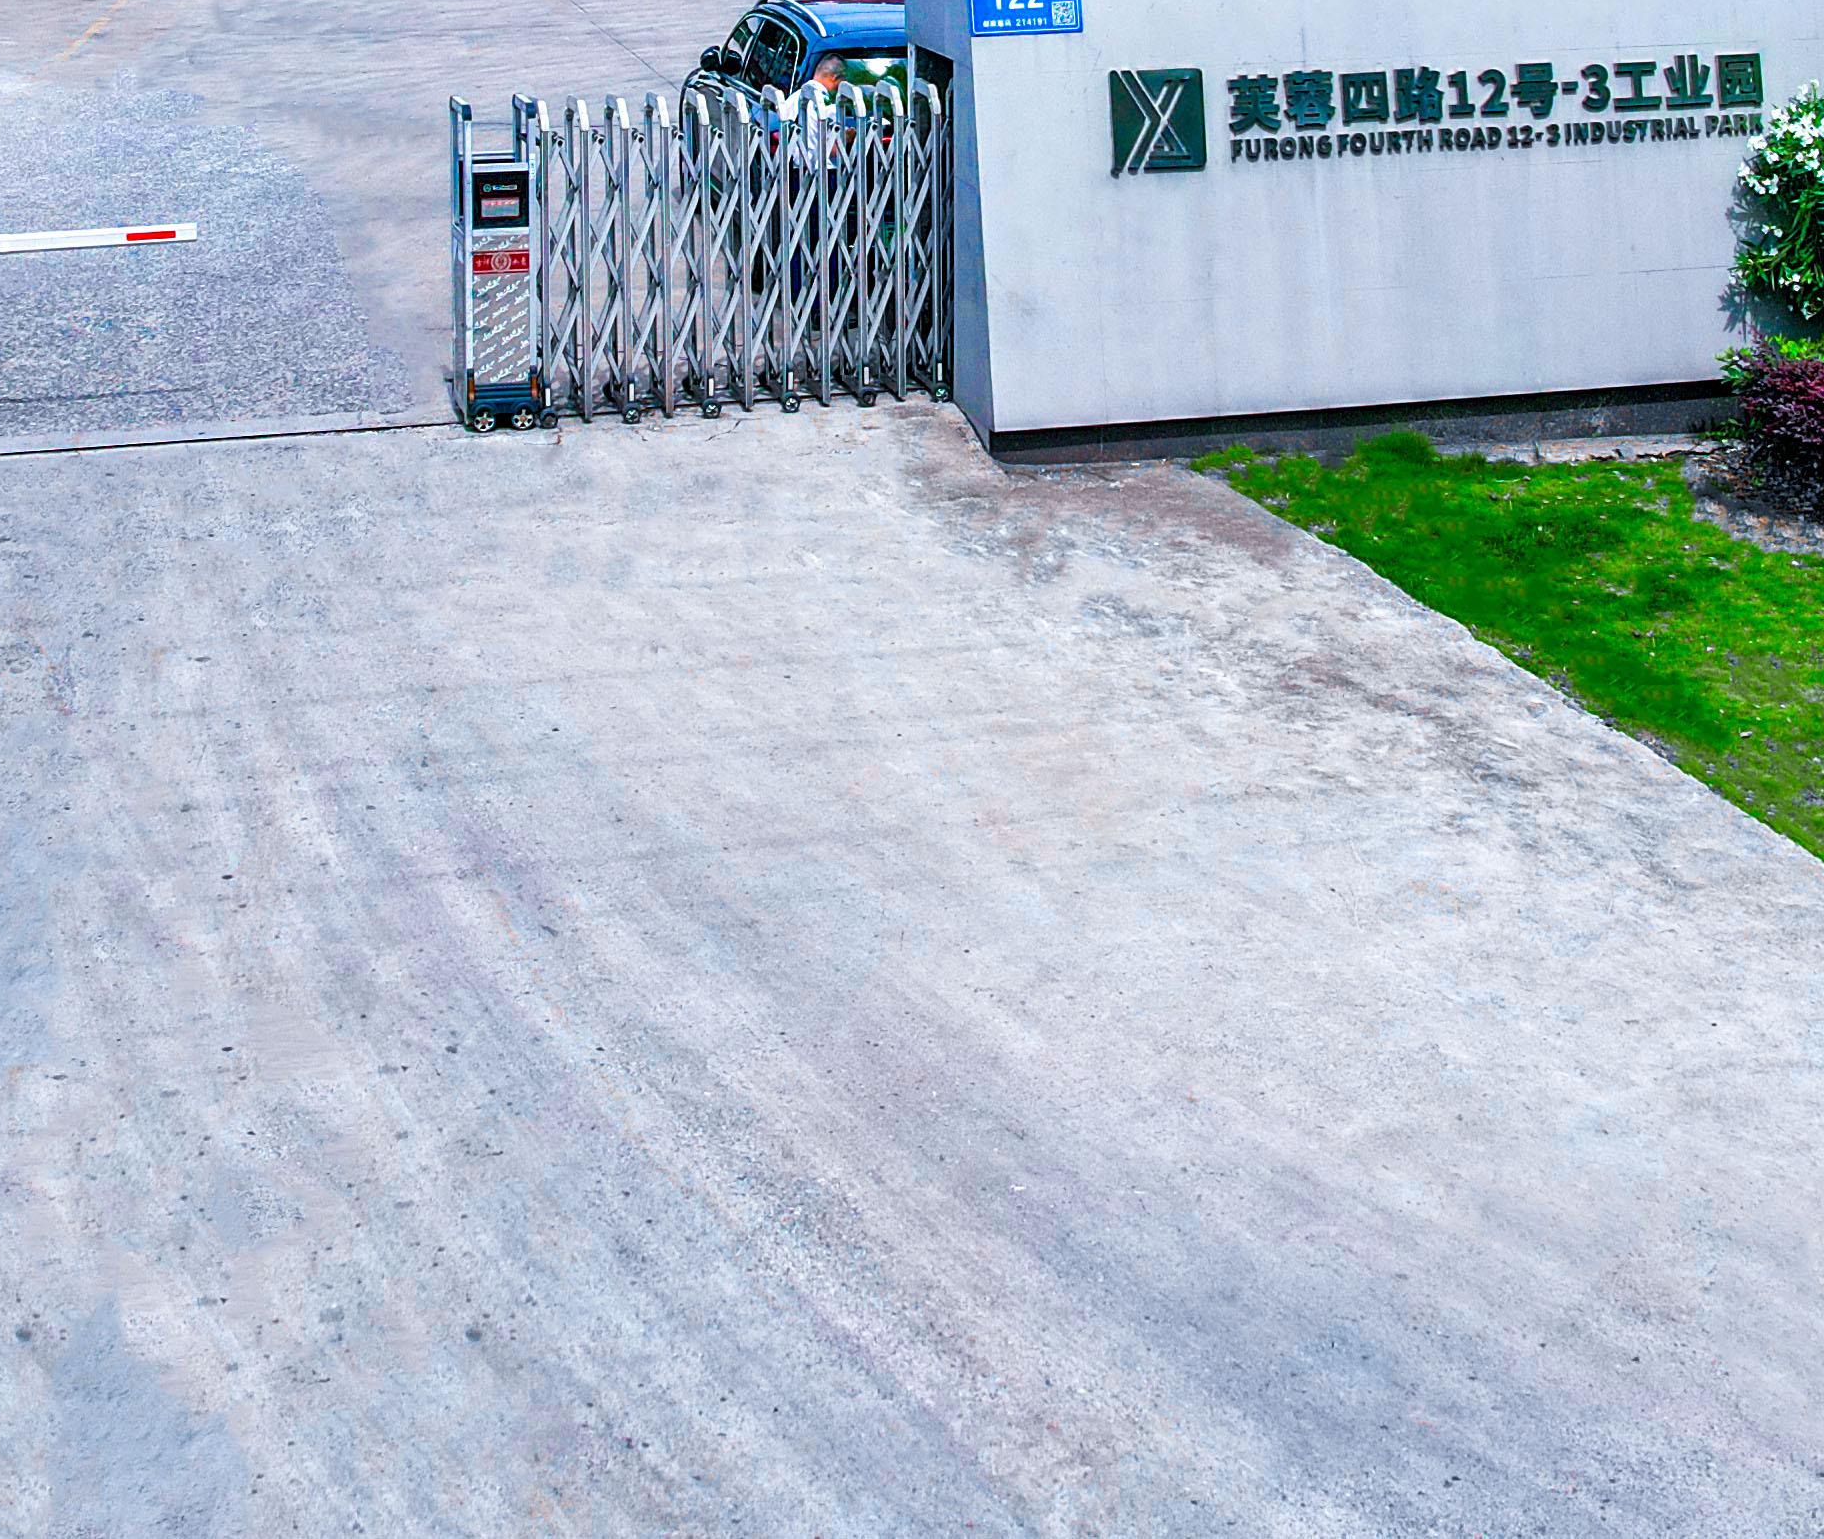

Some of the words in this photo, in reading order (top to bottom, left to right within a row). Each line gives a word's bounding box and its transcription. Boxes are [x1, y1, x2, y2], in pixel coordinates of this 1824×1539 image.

[1227, 53, 1763, 134] 芙蓉四路12号-3工业园
[1230, 135, 1332, 163] FURONG
[1336, 129, 1434, 158] FOURTH
[1438, 126, 1502, 153] ROAD
[1507, 124, 1561, 149] 12-3
[1565, 116, 1701, 146] INDUSTRIAL
[1704, 113, 1763, 138] PARK
